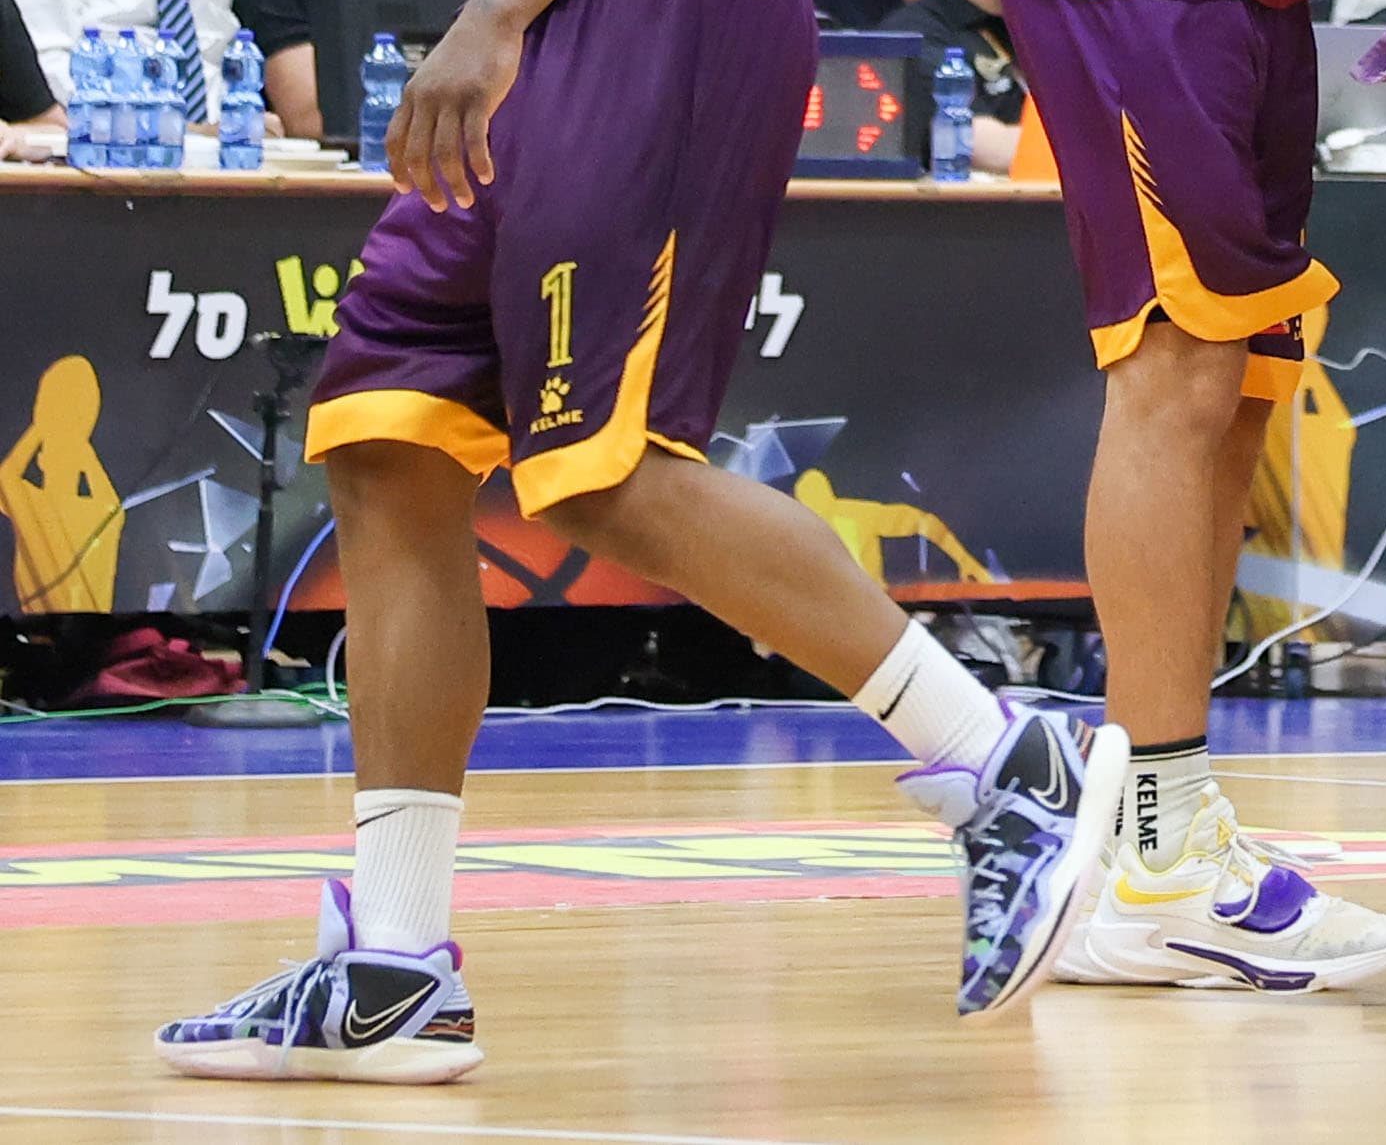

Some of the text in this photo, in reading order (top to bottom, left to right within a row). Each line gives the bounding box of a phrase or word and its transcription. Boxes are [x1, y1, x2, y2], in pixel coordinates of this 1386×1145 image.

[146, 269, 248, 360] סל
[541, 261, 578, 369] 1
[530, 409, 584, 436] KELME
[1136, 772, 1159, 855] KELME
